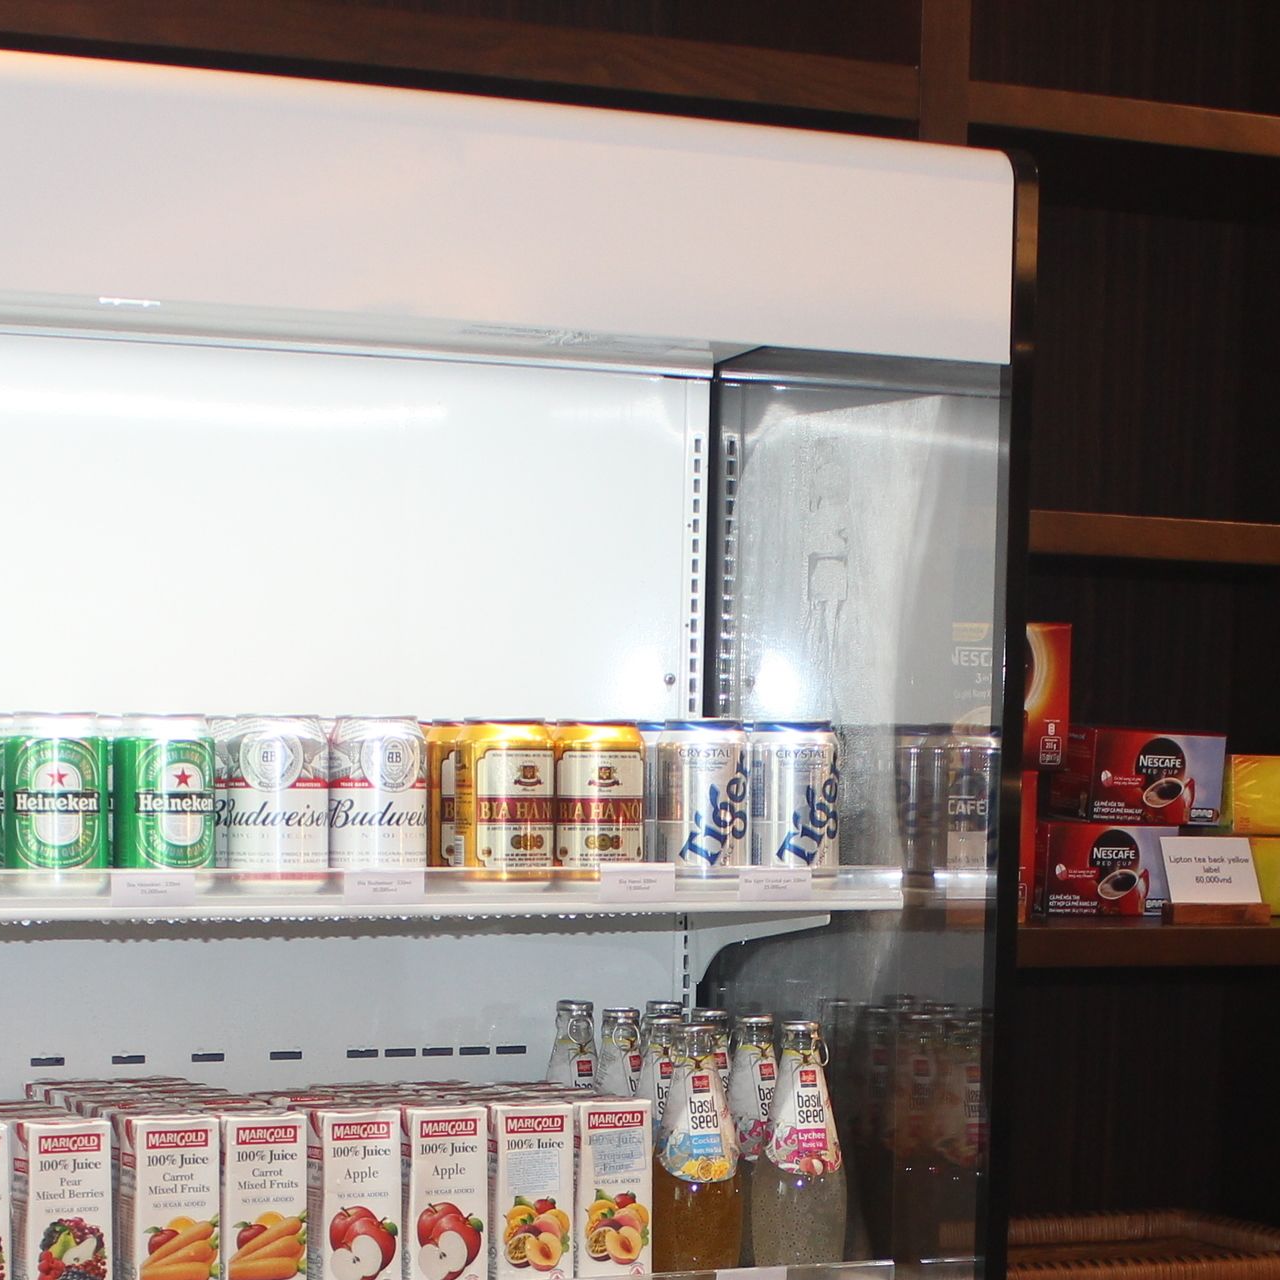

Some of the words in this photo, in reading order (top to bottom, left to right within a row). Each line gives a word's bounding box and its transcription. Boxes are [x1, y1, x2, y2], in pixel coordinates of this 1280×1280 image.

[679, 748, 731, 759] CRYSTAL
[776, 748, 827, 759] CRYSTAL
[15, 793, 98, 811] Heineken
[138, 793, 213, 811] Heineken
[589, 798, 617, 819] HÀ
[679, 750, 748, 866] Tiger
[776, 751, 840, 866] Tiger
[227, 798, 327, 829] Budweiser
[330, 798, 426, 829] Budweis
[480, 801, 511, 819] BIA
[1169, 855, 1193, 866] Lipton
[1203, 866, 1220, 874] label
[689, 1096, 717, 1115] basil
[796, 1091, 822, 1109] basil
[589, 1113, 642, 1128] MARIGOLD
[691, 1113, 718, 1129] seed
[798, 1108, 824, 1124] seed
[334, 1123, 388, 1140] MARIGOLD
[422, 1120, 474, 1136] MARIGOLD
[507, 1117, 562, 1132] MARIGOLD
[148, 1132, 206, 1147] MARIGOLD
[238, 1128, 295, 1144] MARIGOLD
[588, 1135, 614, 1146] 100%
[616, 1134, 644, 1149] Juice
[798, 1130, 826, 1141] Lychee
[40, 1136, 98, 1153] MARIGOLD
[420, 1143, 448, 1154] 100%
[450, 1142, 478, 1157] Juice
[506, 1139, 534, 1151] 100%
[536, 1137, 564, 1150] Juice
[236, 1150, 265, 1162] 100%
[268, 1149, 298, 1164] Juice
[332, 1146, 360, 1158] 100%
[362, 1145, 392, 1160] Juice
[39, 1159, 70, 1171] 100%
[72, 1158, 101, 1172] Juice
[147, 1154, 176, 1166] 100%
[179, 1153, 208, 1168] Juice
[162, 1172, 194, 1182] Carrot
[252, 1168, 283, 1178] Carrot
[344, 1166, 380, 1184] Apple
[432, 1163, 466, 1180] Apple
[60, 1176, 82, 1186] Pear
[237, 1180, 266, 1191] Mixed
[270, 1179, 298, 1190] Fruits
[36, 1190, 66, 1200] Mixed
[69, 1188, 104, 1199] Berries
[148, 1185, 178, 1196] Mixed
[180, 1183, 210, 1194] Fruits
